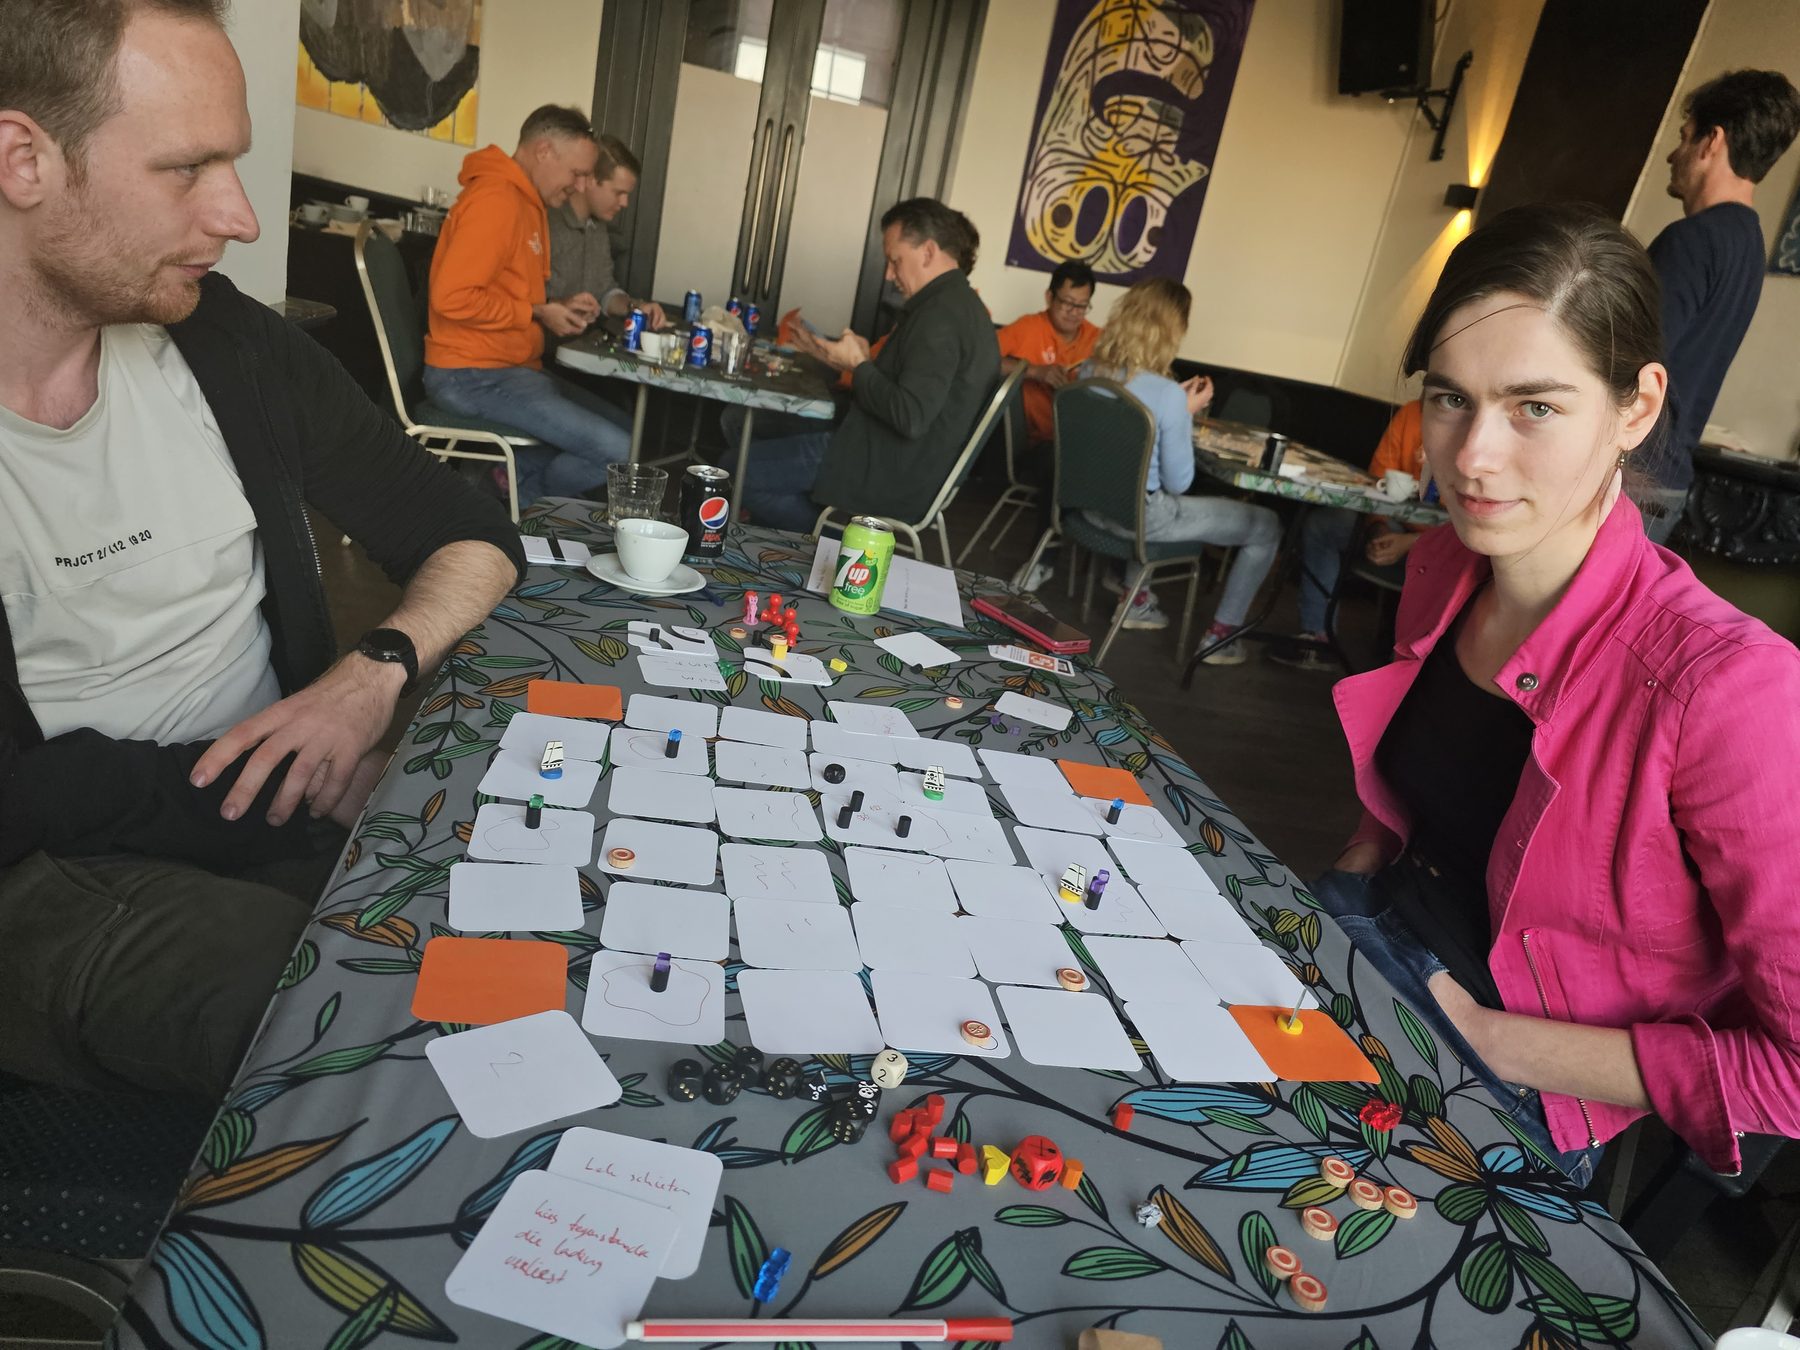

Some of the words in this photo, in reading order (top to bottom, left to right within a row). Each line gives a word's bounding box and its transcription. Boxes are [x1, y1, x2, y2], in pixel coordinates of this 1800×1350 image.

[55, 552, 94, 568] PRJCT
[844, 582, 866, 596] free
[877, 1068, 887, 1083] 2
[514, 1229, 543, 1249] die
